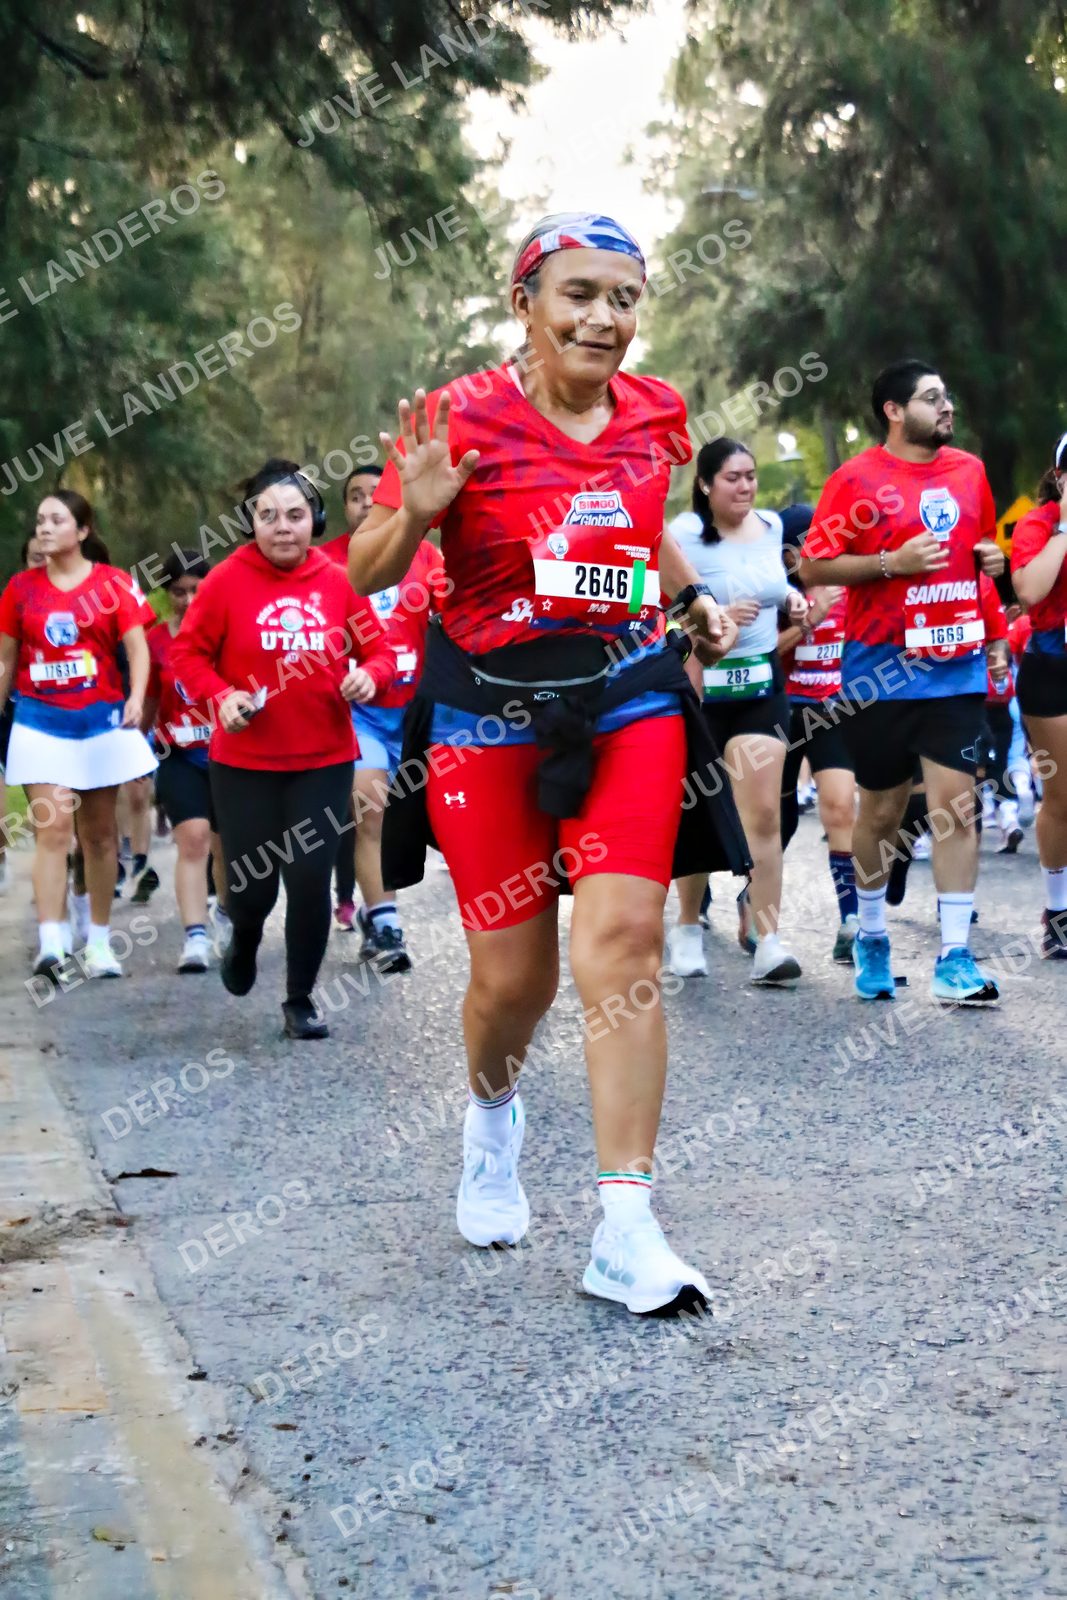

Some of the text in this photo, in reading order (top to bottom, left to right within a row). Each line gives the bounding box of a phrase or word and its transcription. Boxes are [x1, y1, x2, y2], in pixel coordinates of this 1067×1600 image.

[575, 565, 628, 599] 2646
[260, 632, 325, 651] UTAH
[931, 626, 964, 644] 1669
[817, 645, 839, 660] 2271
[727, 669, 750, 685] 282
